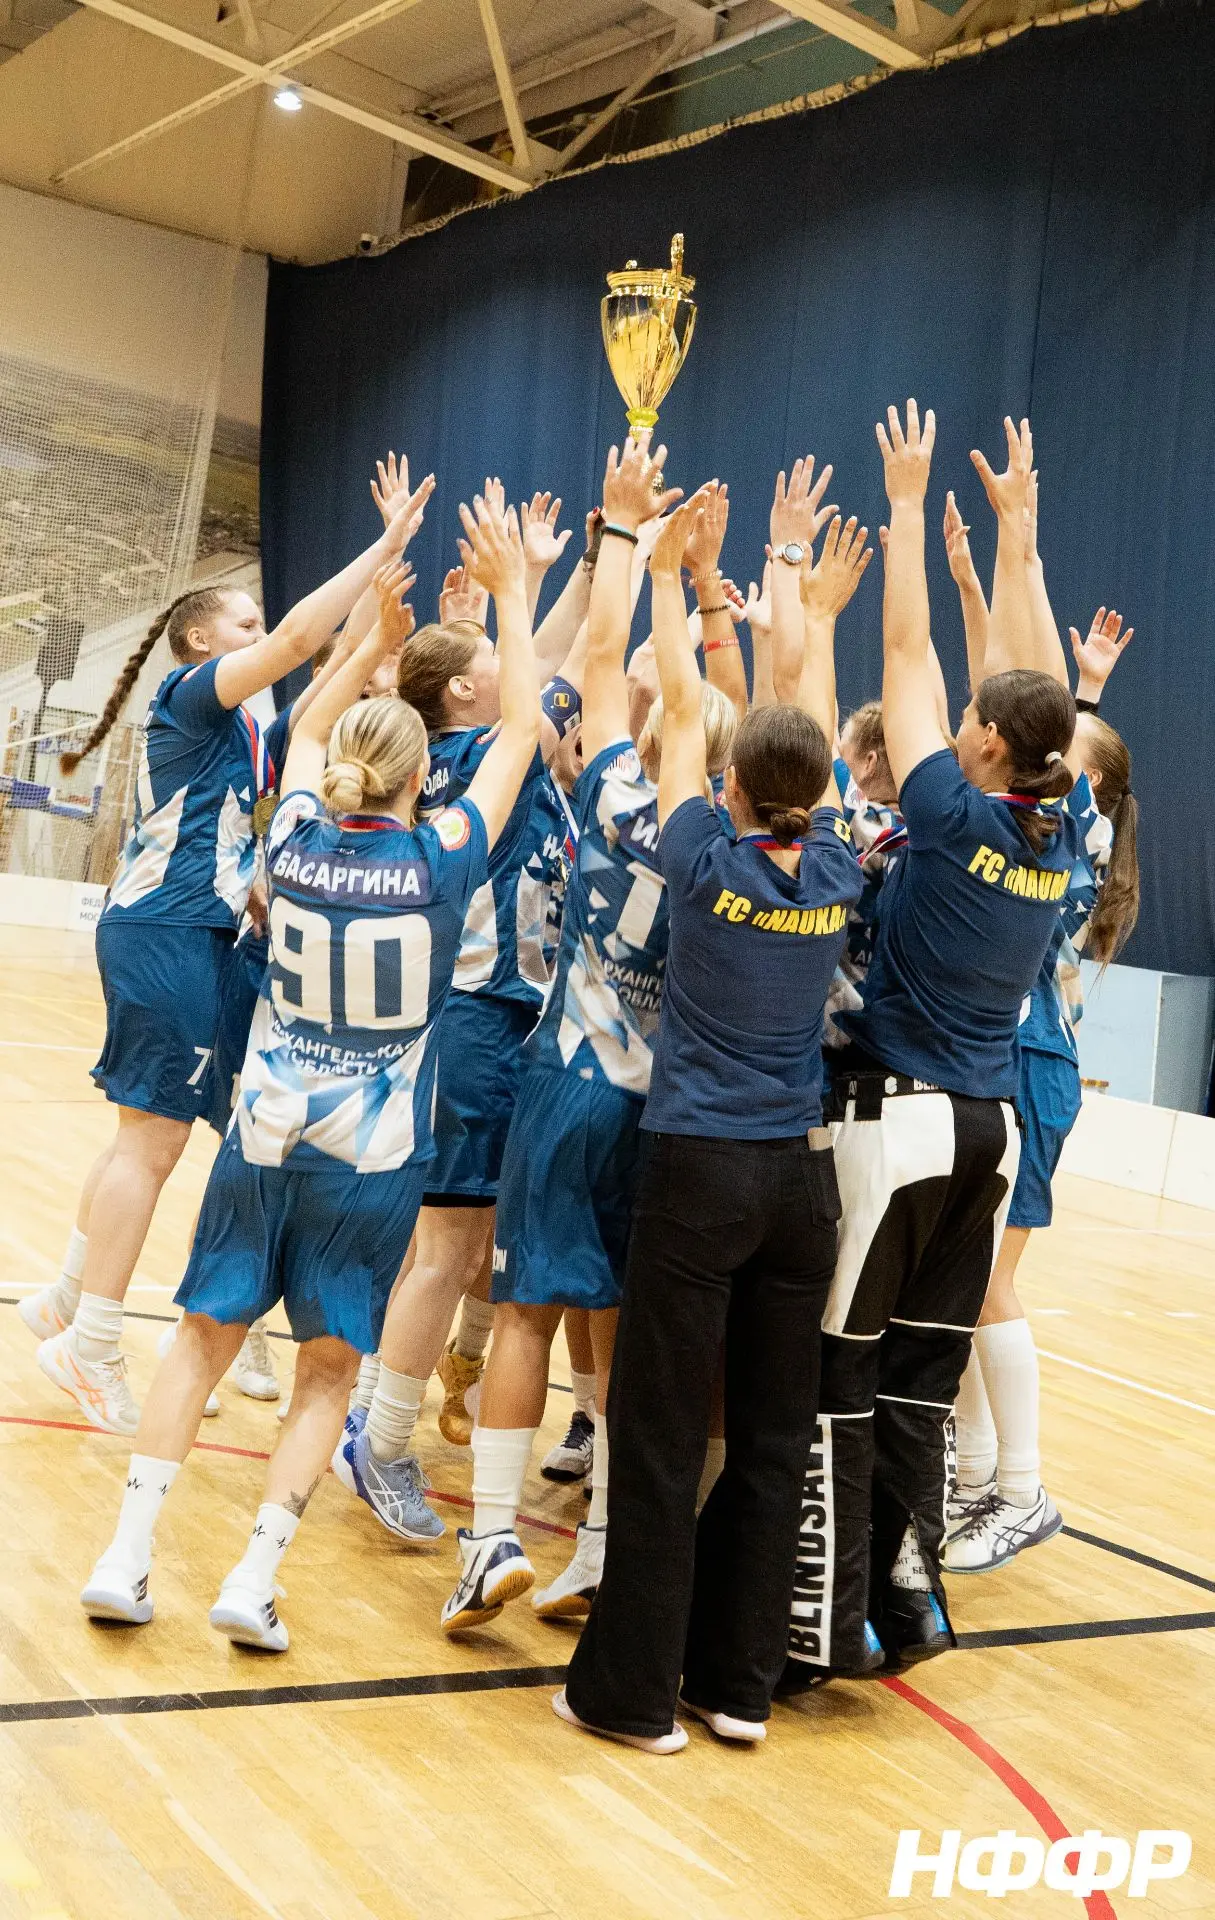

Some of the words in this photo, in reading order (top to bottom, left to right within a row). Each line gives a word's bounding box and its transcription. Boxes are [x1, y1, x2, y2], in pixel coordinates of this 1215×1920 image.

[273, 850, 421, 896] БАСАРГИНА
[967, 844, 1006, 884] FC
[712, 888, 752, 922] FC
[269, 895, 432, 1030] 90
